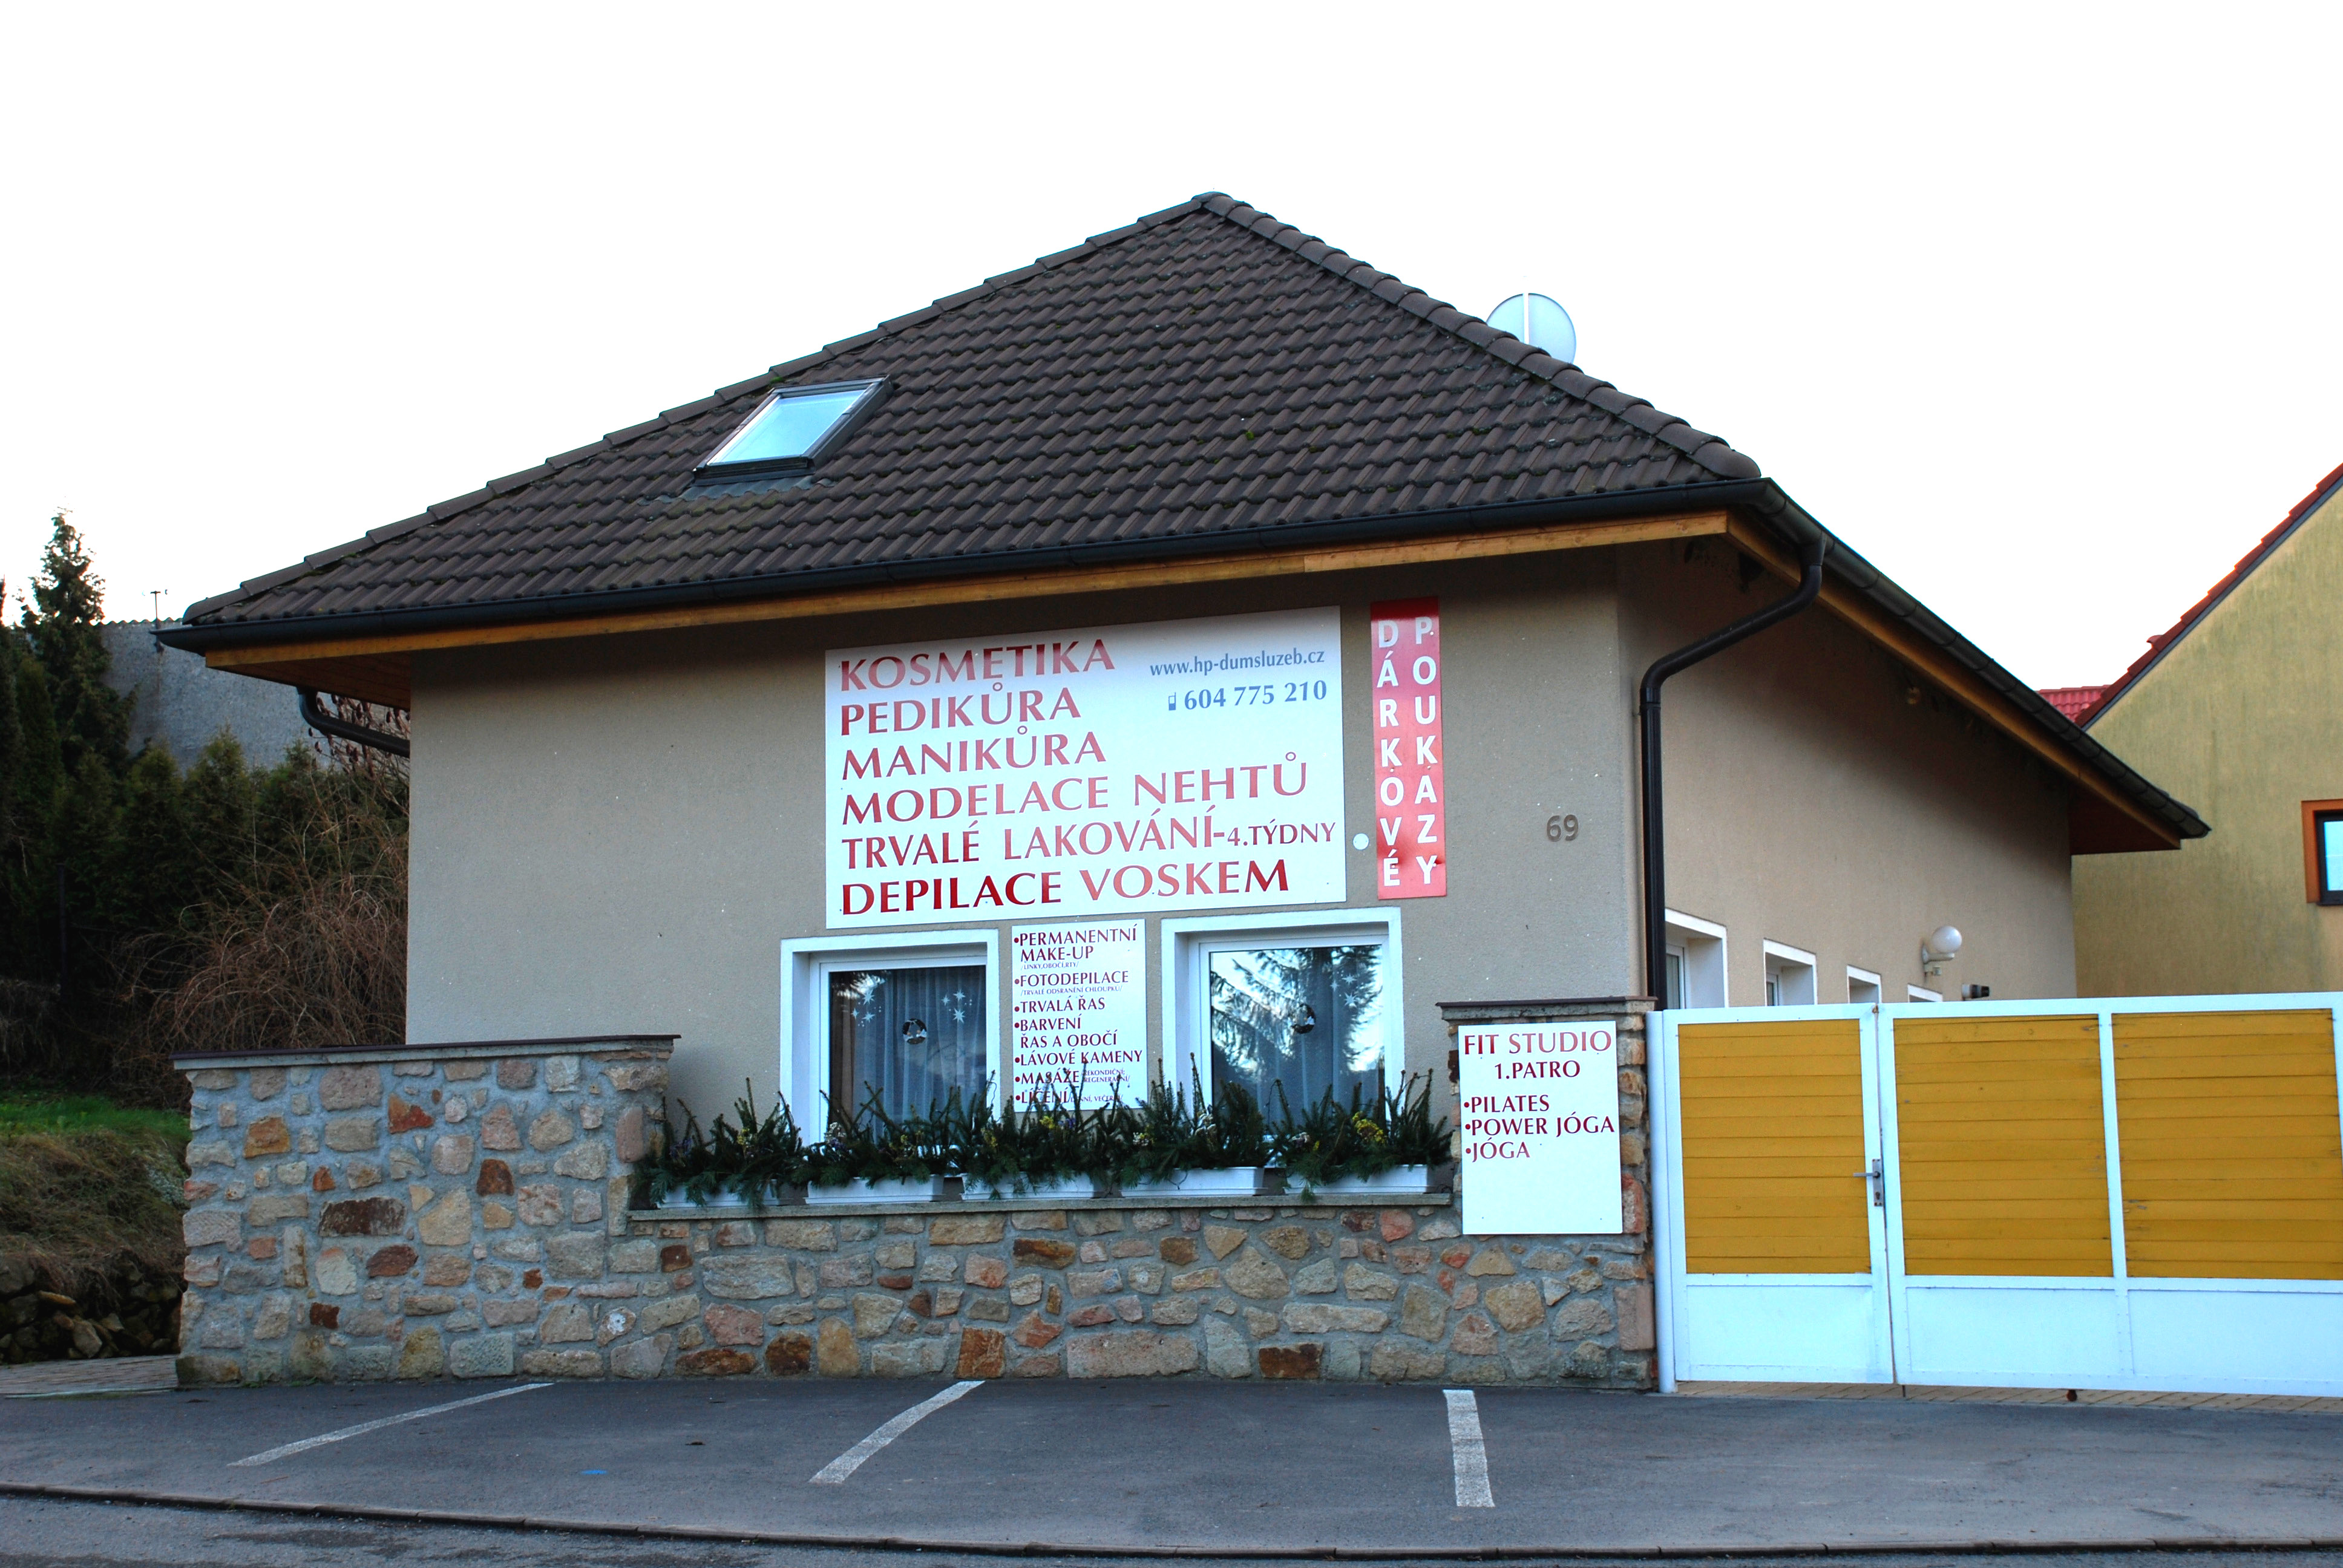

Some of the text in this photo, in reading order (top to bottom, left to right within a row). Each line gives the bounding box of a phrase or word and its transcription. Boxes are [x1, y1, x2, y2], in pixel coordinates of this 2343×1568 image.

[841, 639, 1115, 691] KOSMETIKA
[1150, 647, 1326, 678] www.hp-dumsluzeb.cz
[1184, 680, 1328, 710] 604 775 210
[841, 682, 1081, 736] PEDIKŮRA
[842, 725, 1107, 780] MANIKŮRA
[1377, 619, 1404, 887] DÁRKOVÉ
[1412, 616, 1438, 886] POUKAZY
[842, 751, 1308, 825] MODELACE NEHTŮ
[1547, 814, 1579, 842] 69
[842, 820, 980, 869] TRVALÉ
[842, 859, 1289, 916] DEPILACE VOSKEM
[1020, 923, 1138, 946] PERMANENTNÍ
[1020, 946, 1094, 962] MAKE-UP
[1020, 970, 1129, 987] FOTODEPILACE
[1020, 995, 1106, 1013] TRVALÁ ŘAS
[1020, 1013, 1083, 1031] BARVENÍ
[1020, 1029, 1118, 1048] ŘAS A OBOČÍ
[1464, 1030, 1612, 1055] FIT STUDIO
[1021, 1048, 1142, 1066] LÁVOVÉ KAMENY
[1021, 1067, 1080, 1084] MASÁŽE
[1495, 1060, 1581, 1080] 1.PATRO
[1471, 1094, 1550, 1113] PILATES
[1472, 1111, 1615, 1137] POWER JÓGA
[1472, 1137, 1530, 1162] JÓGA
